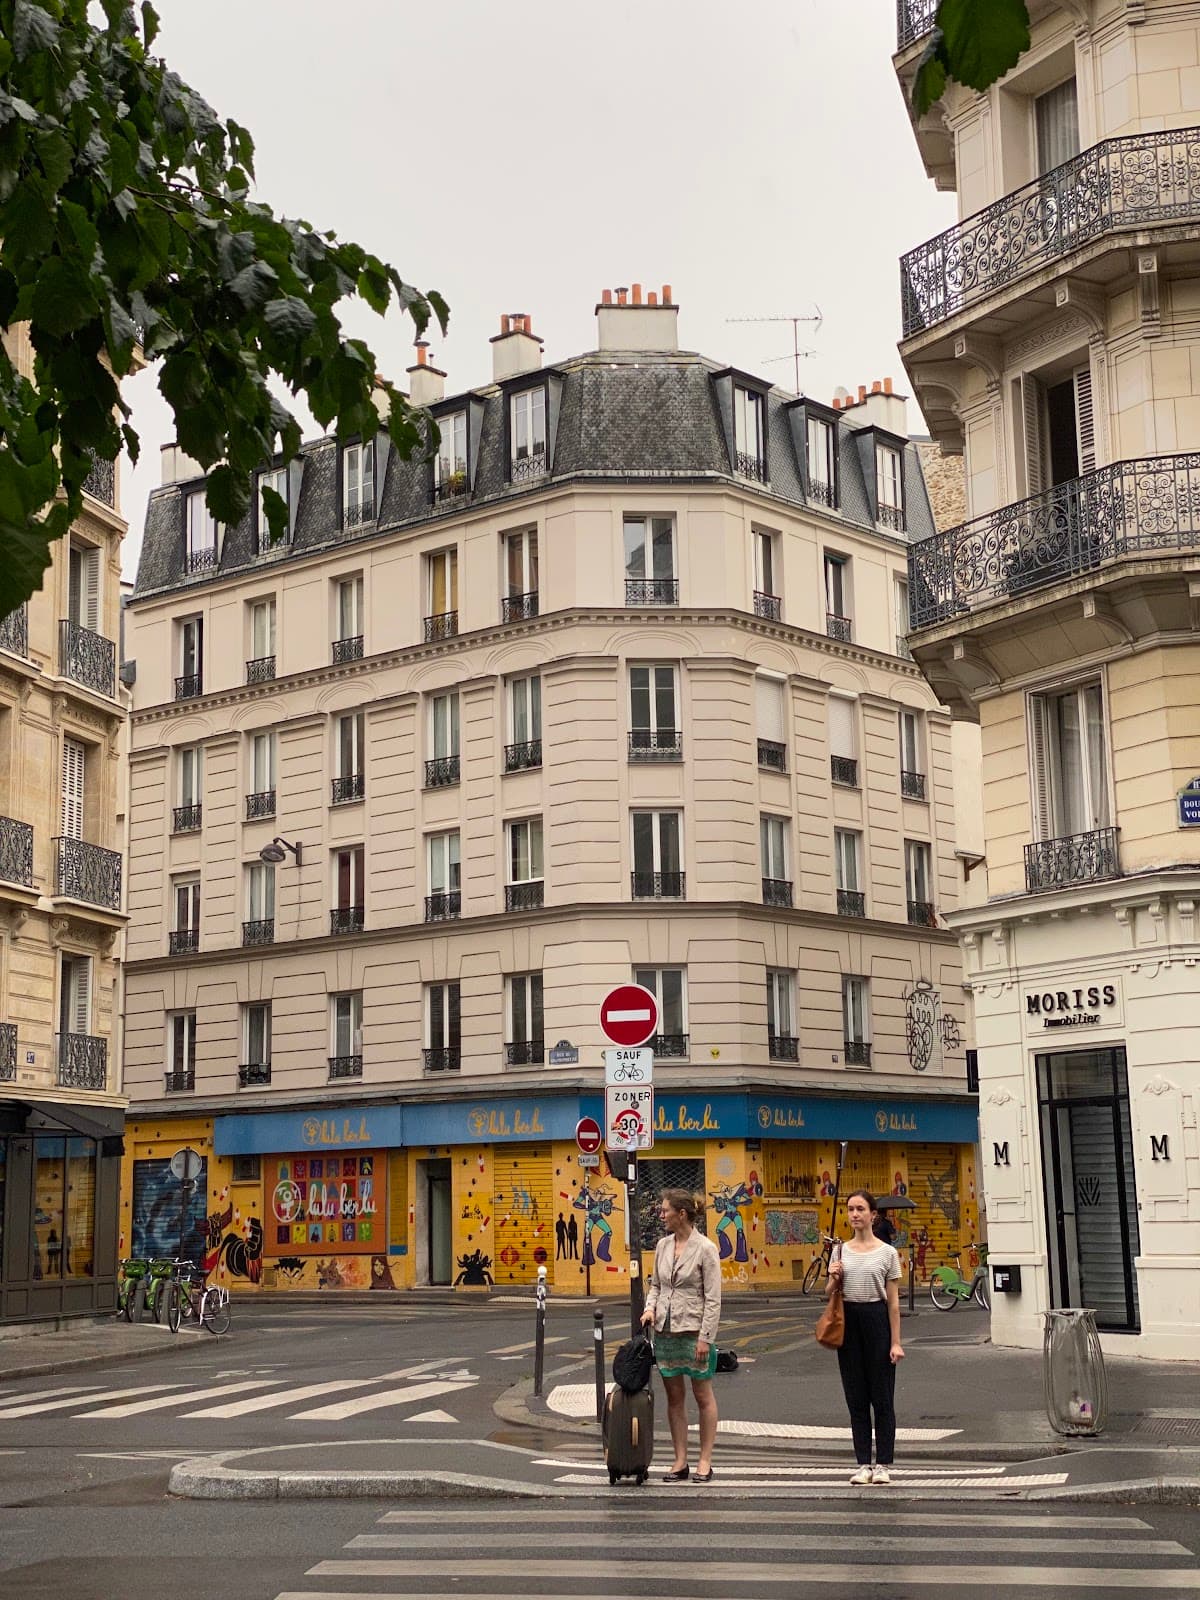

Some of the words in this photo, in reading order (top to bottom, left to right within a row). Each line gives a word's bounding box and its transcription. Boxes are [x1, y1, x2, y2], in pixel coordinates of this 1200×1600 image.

[1026, 985, 1115, 1014] MORISS
[616, 1051, 641, 1060] SAUF
[320, 1119, 341, 1144] lulu
[343, 1116, 372, 1143] berlu
[487, 1109, 511, 1136] lulu
[513, 1106, 545, 1136] berlu
[621, 1118, 638, 1131] 30
[677, 1104, 720, 1132] berlu
[992, 1141, 1010, 1166] M
[1150, 1134, 1169, 1161] M
[306, 1183, 335, 1217] lulu
[338, 1179, 378, 1216] berlu
